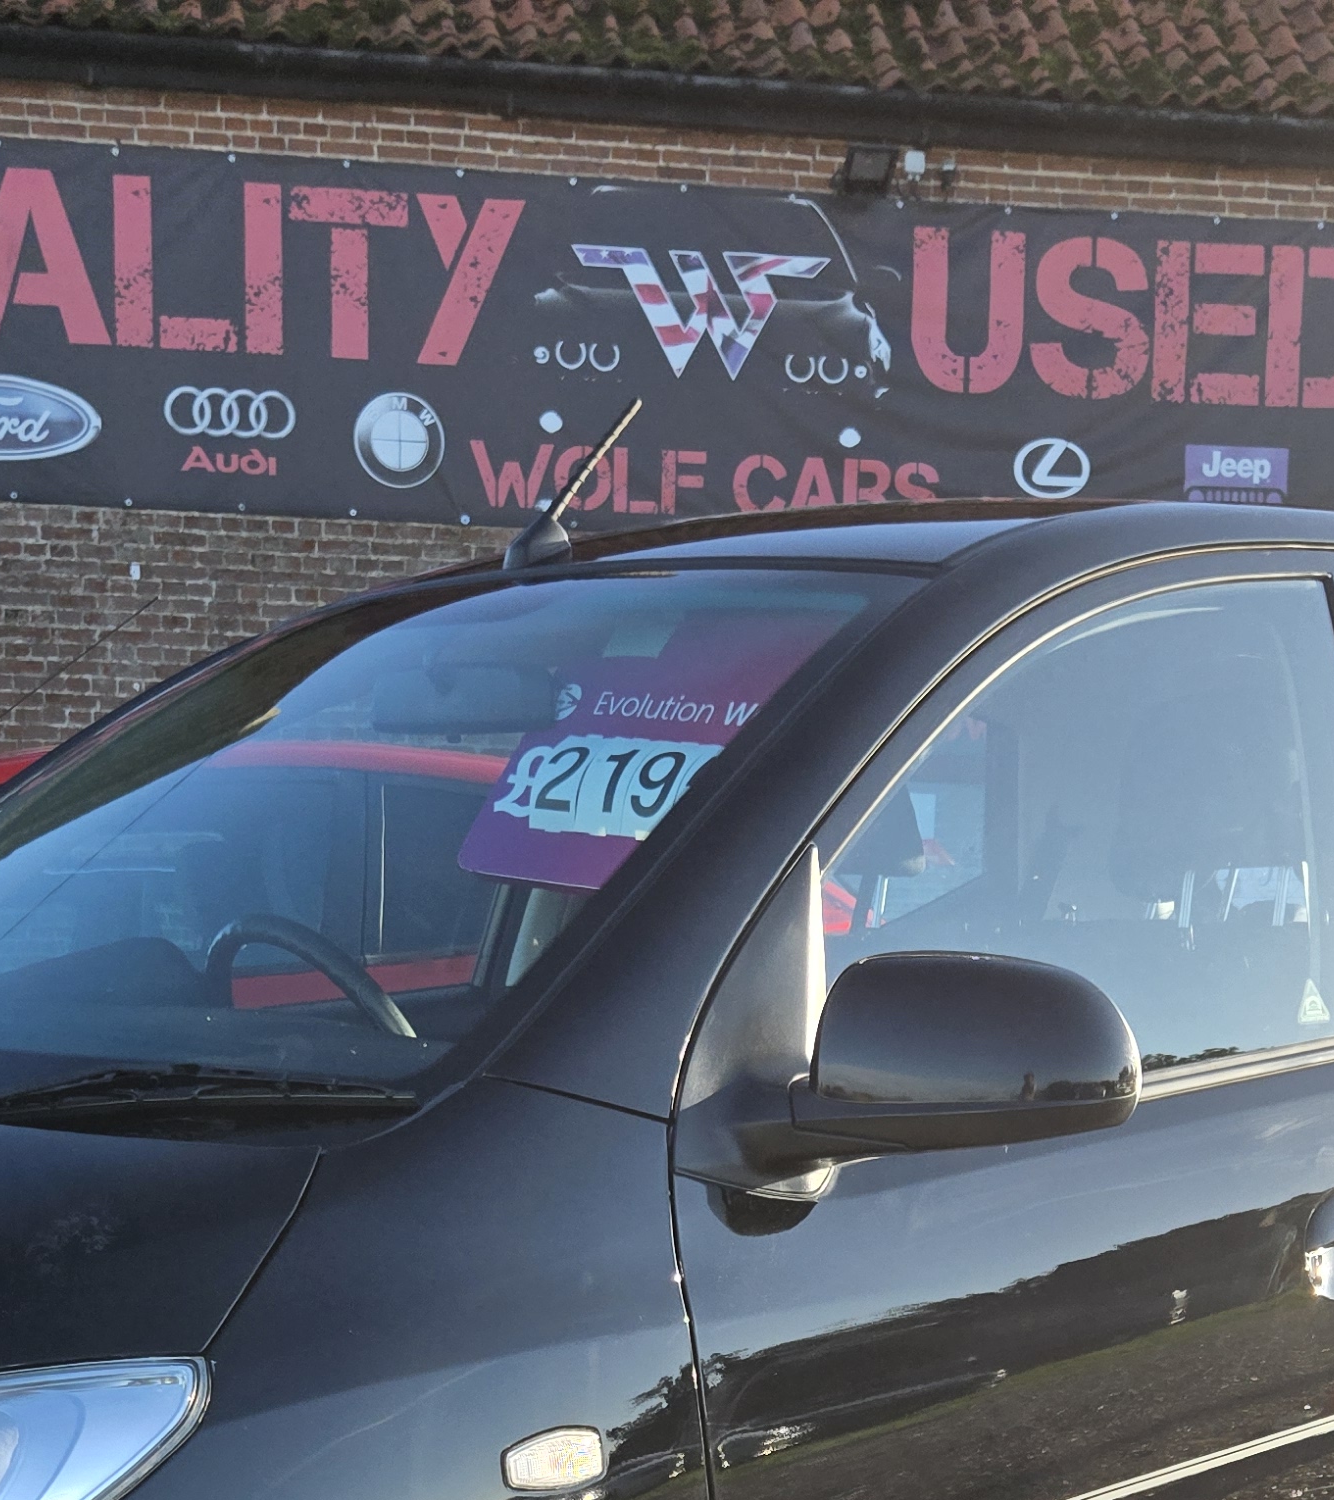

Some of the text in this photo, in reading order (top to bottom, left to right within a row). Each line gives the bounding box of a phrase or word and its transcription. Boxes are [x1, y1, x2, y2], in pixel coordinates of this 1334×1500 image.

[180, 445, 277, 476] Audi
[470, 439, 940, 515] WOLF CARS
[1202, 450, 1271, 484] Jeep
[593, 691, 715, 724] Evolution
[494, 746, 713, 818] £219
